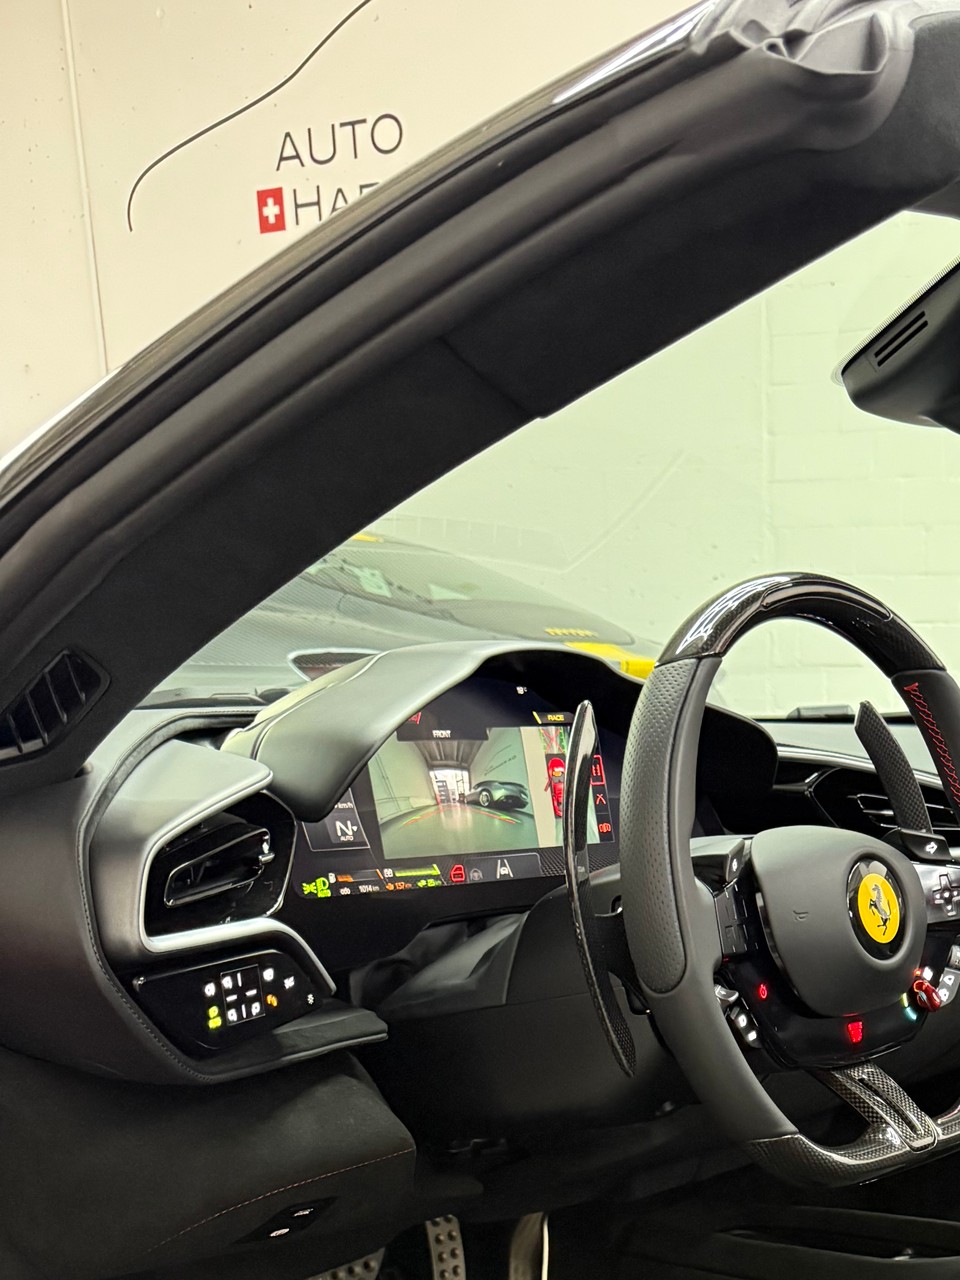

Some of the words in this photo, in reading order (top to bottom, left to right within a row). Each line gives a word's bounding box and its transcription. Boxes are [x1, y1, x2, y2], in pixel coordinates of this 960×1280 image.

[276, 113, 403, 172] AUTO
[292, 181, 379, 226] HA
[432, 730, 451, 738] FRONT
[335, 820, 353, 837] N
